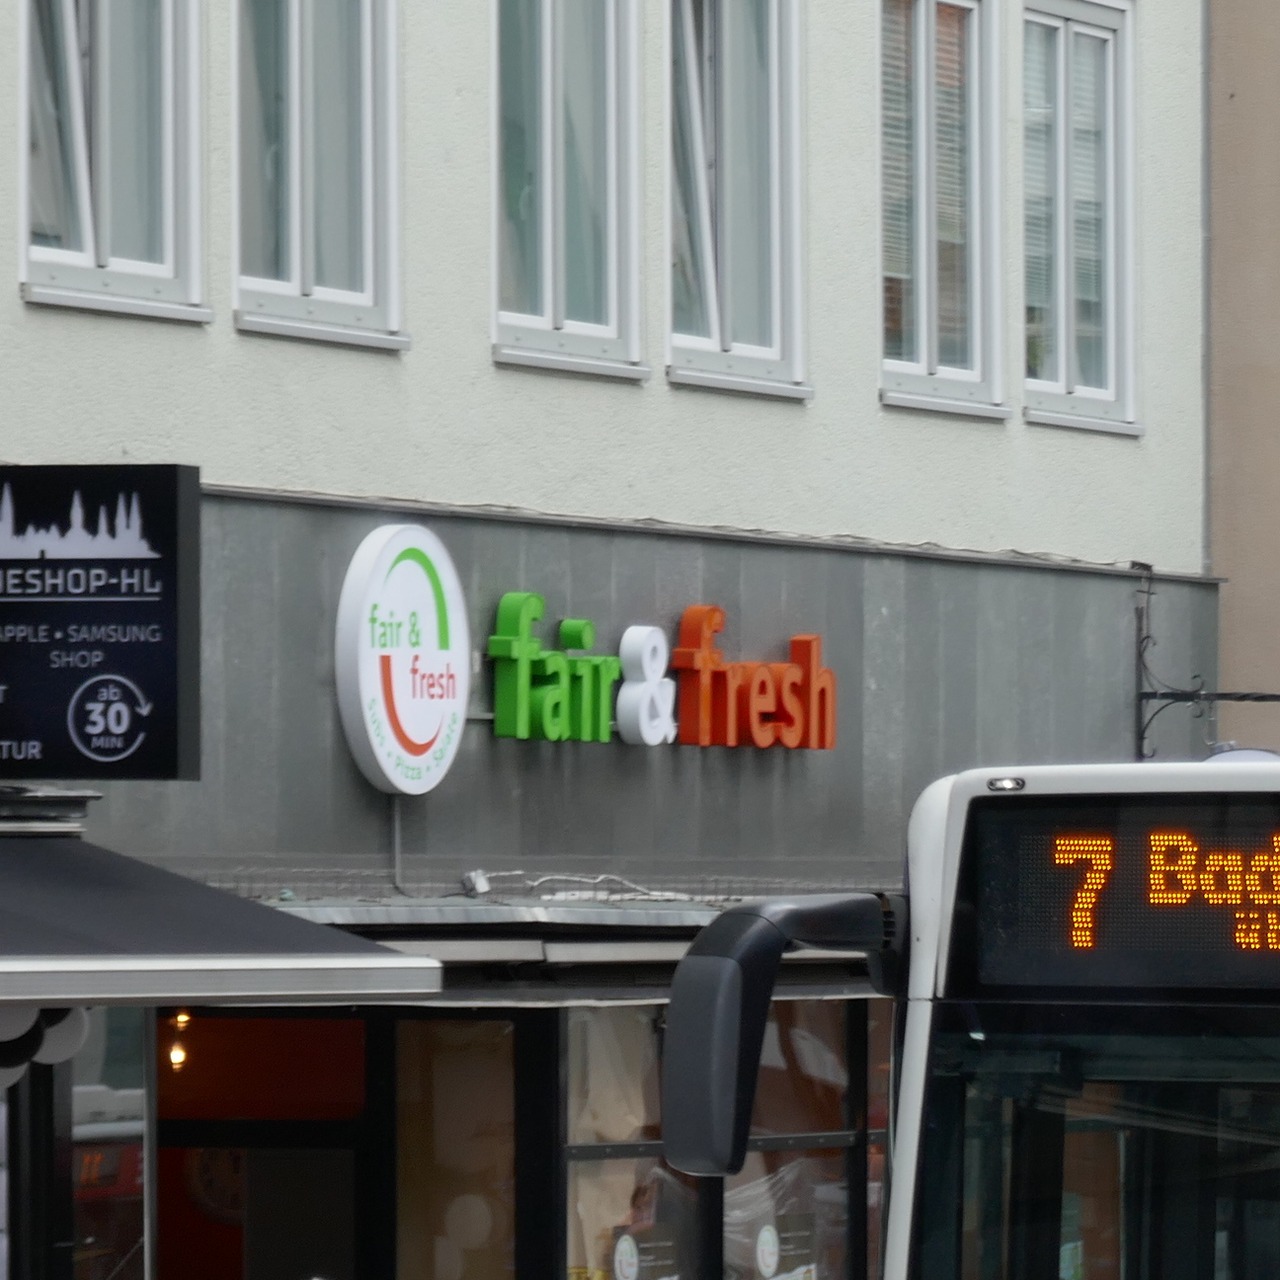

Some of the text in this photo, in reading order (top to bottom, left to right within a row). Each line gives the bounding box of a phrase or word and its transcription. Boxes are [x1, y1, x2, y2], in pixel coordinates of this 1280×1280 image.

[0, 568, 162, 594] ESHOP-HL
[67, 625, 162, 643] SAMSUNG
[369, 603, 420, 648] fair &
[50, 651, 104, 669] SHOP
[489, 592, 837, 750] fair & fresh
[410, 654, 456, 700] fresh
[97, 684, 122, 701] ab
[84, 702, 131, 735] 30
[91, 736, 124, 750] MIN
[1054, 838, 1113, 949] 7
